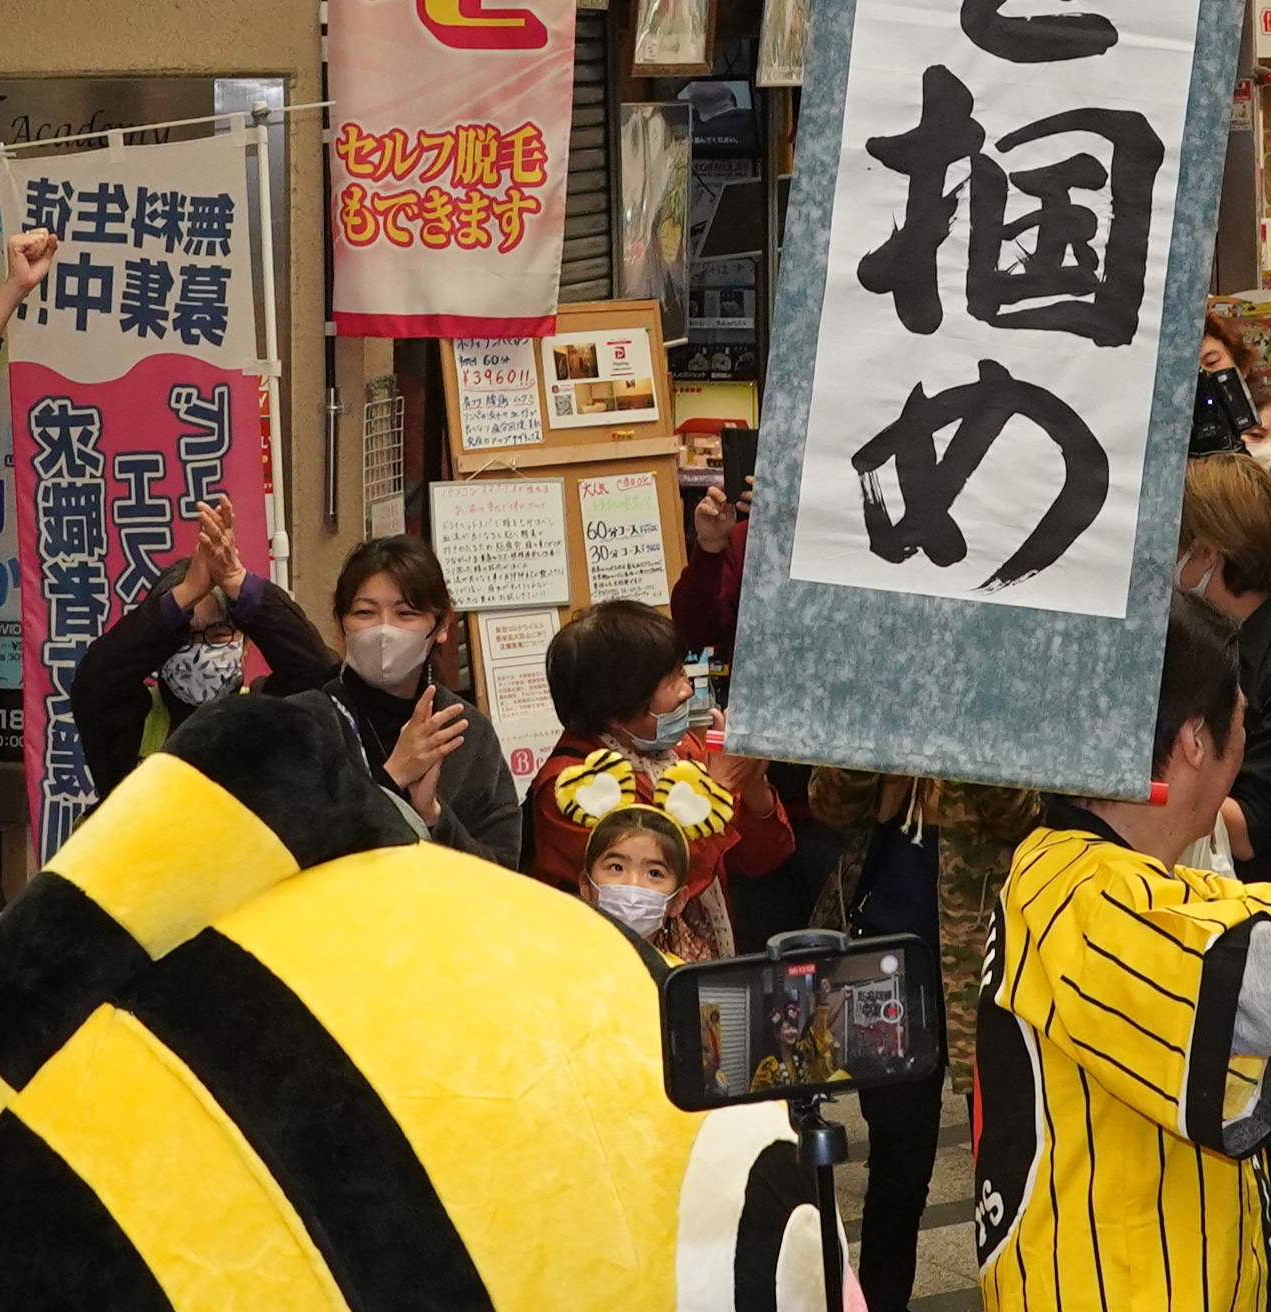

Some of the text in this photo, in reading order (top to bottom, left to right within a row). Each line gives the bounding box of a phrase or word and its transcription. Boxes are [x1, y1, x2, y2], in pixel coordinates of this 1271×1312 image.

[335, 122, 548, 186] セルフ脱毛
[338, 186, 541, 253] もできます
